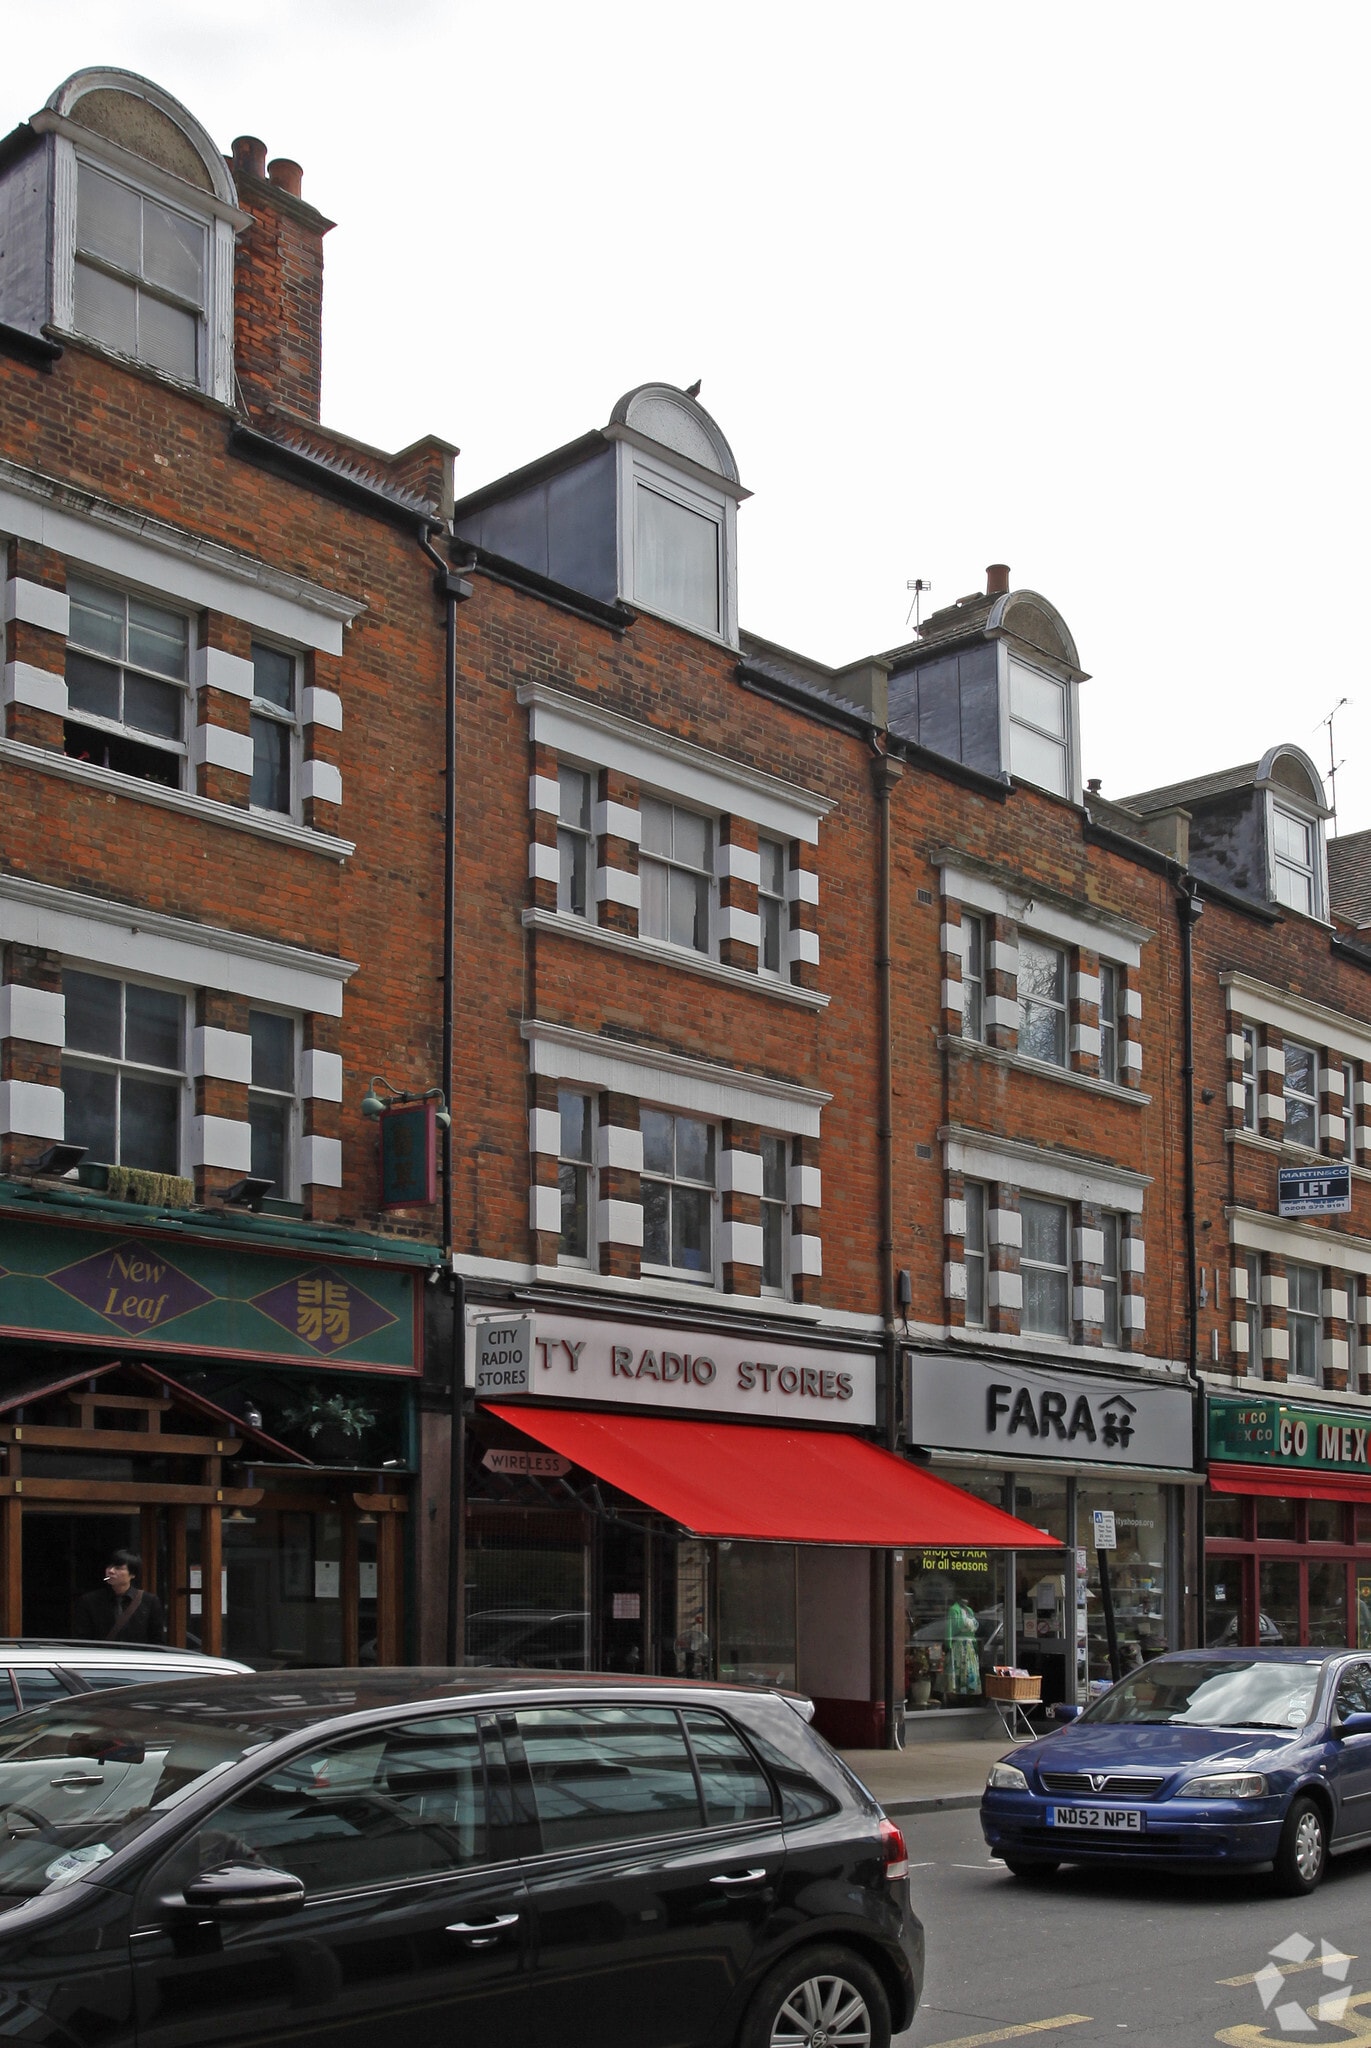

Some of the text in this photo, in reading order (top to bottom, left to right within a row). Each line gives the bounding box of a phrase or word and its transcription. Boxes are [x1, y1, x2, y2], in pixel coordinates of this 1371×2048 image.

[1281, 1169, 1347, 1179] MARTIN&CO
[1299, 1181, 1331, 1197] LET
[107, 1253, 166, 1284] New
[104, 1288, 169, 1324] Leaf
[488, 1329, 518, 1345] CITY
[481, 1349, 523, 1366] RADIO
[535, 1337, 854, 1400] TY RADIO STORES
[478, 1370, 526, 1387] STORES
[987, 1384, 1097, 1442] FARA
[491, 1455, 560, 1471] WIRELESS
[922, 1558, 988, 1571] for all seasons
[1057, 1809, 1138, 1828] ND52 NPE
